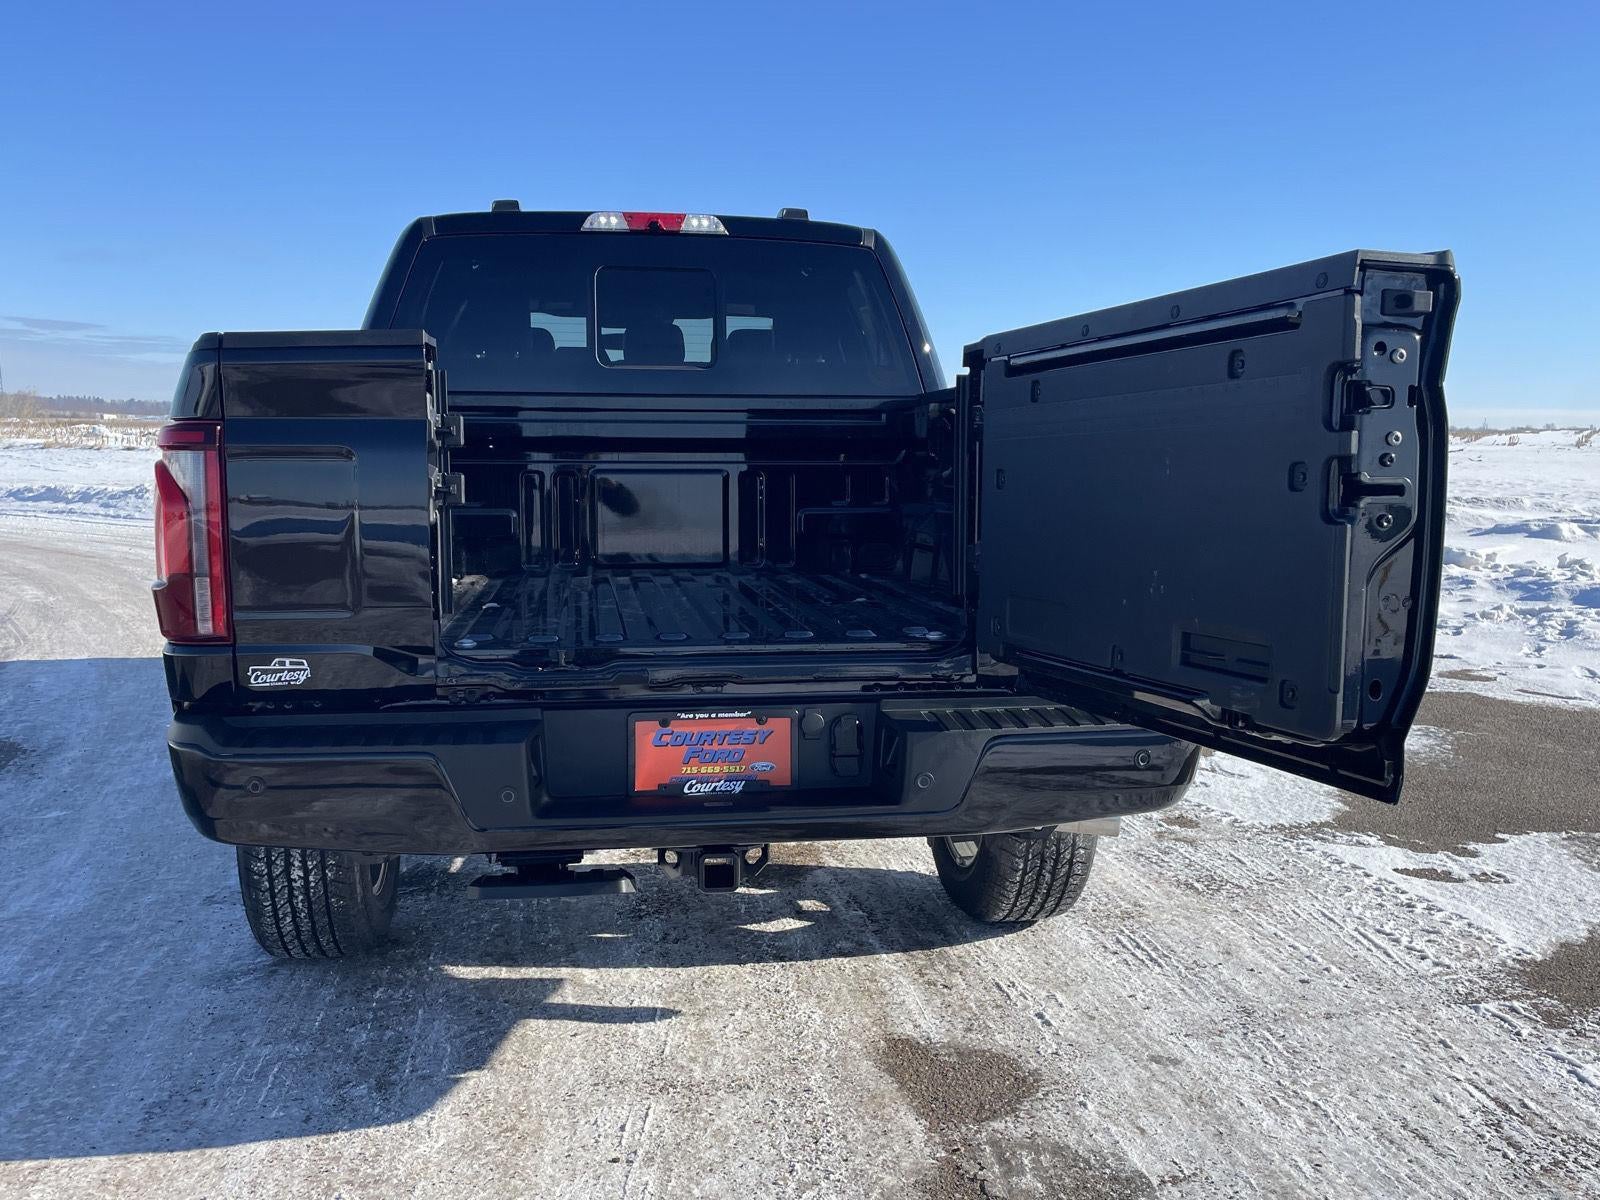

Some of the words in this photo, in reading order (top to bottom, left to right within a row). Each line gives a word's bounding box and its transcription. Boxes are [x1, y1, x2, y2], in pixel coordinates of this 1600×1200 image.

[250, 670, 308, 684] Courtesy
[695, 712, 709, 720] you
[653, 728, 773, 746] COURTESY
[683, 747, 745, 763] FORD
[684, 780, 745, 793] Courtesy
